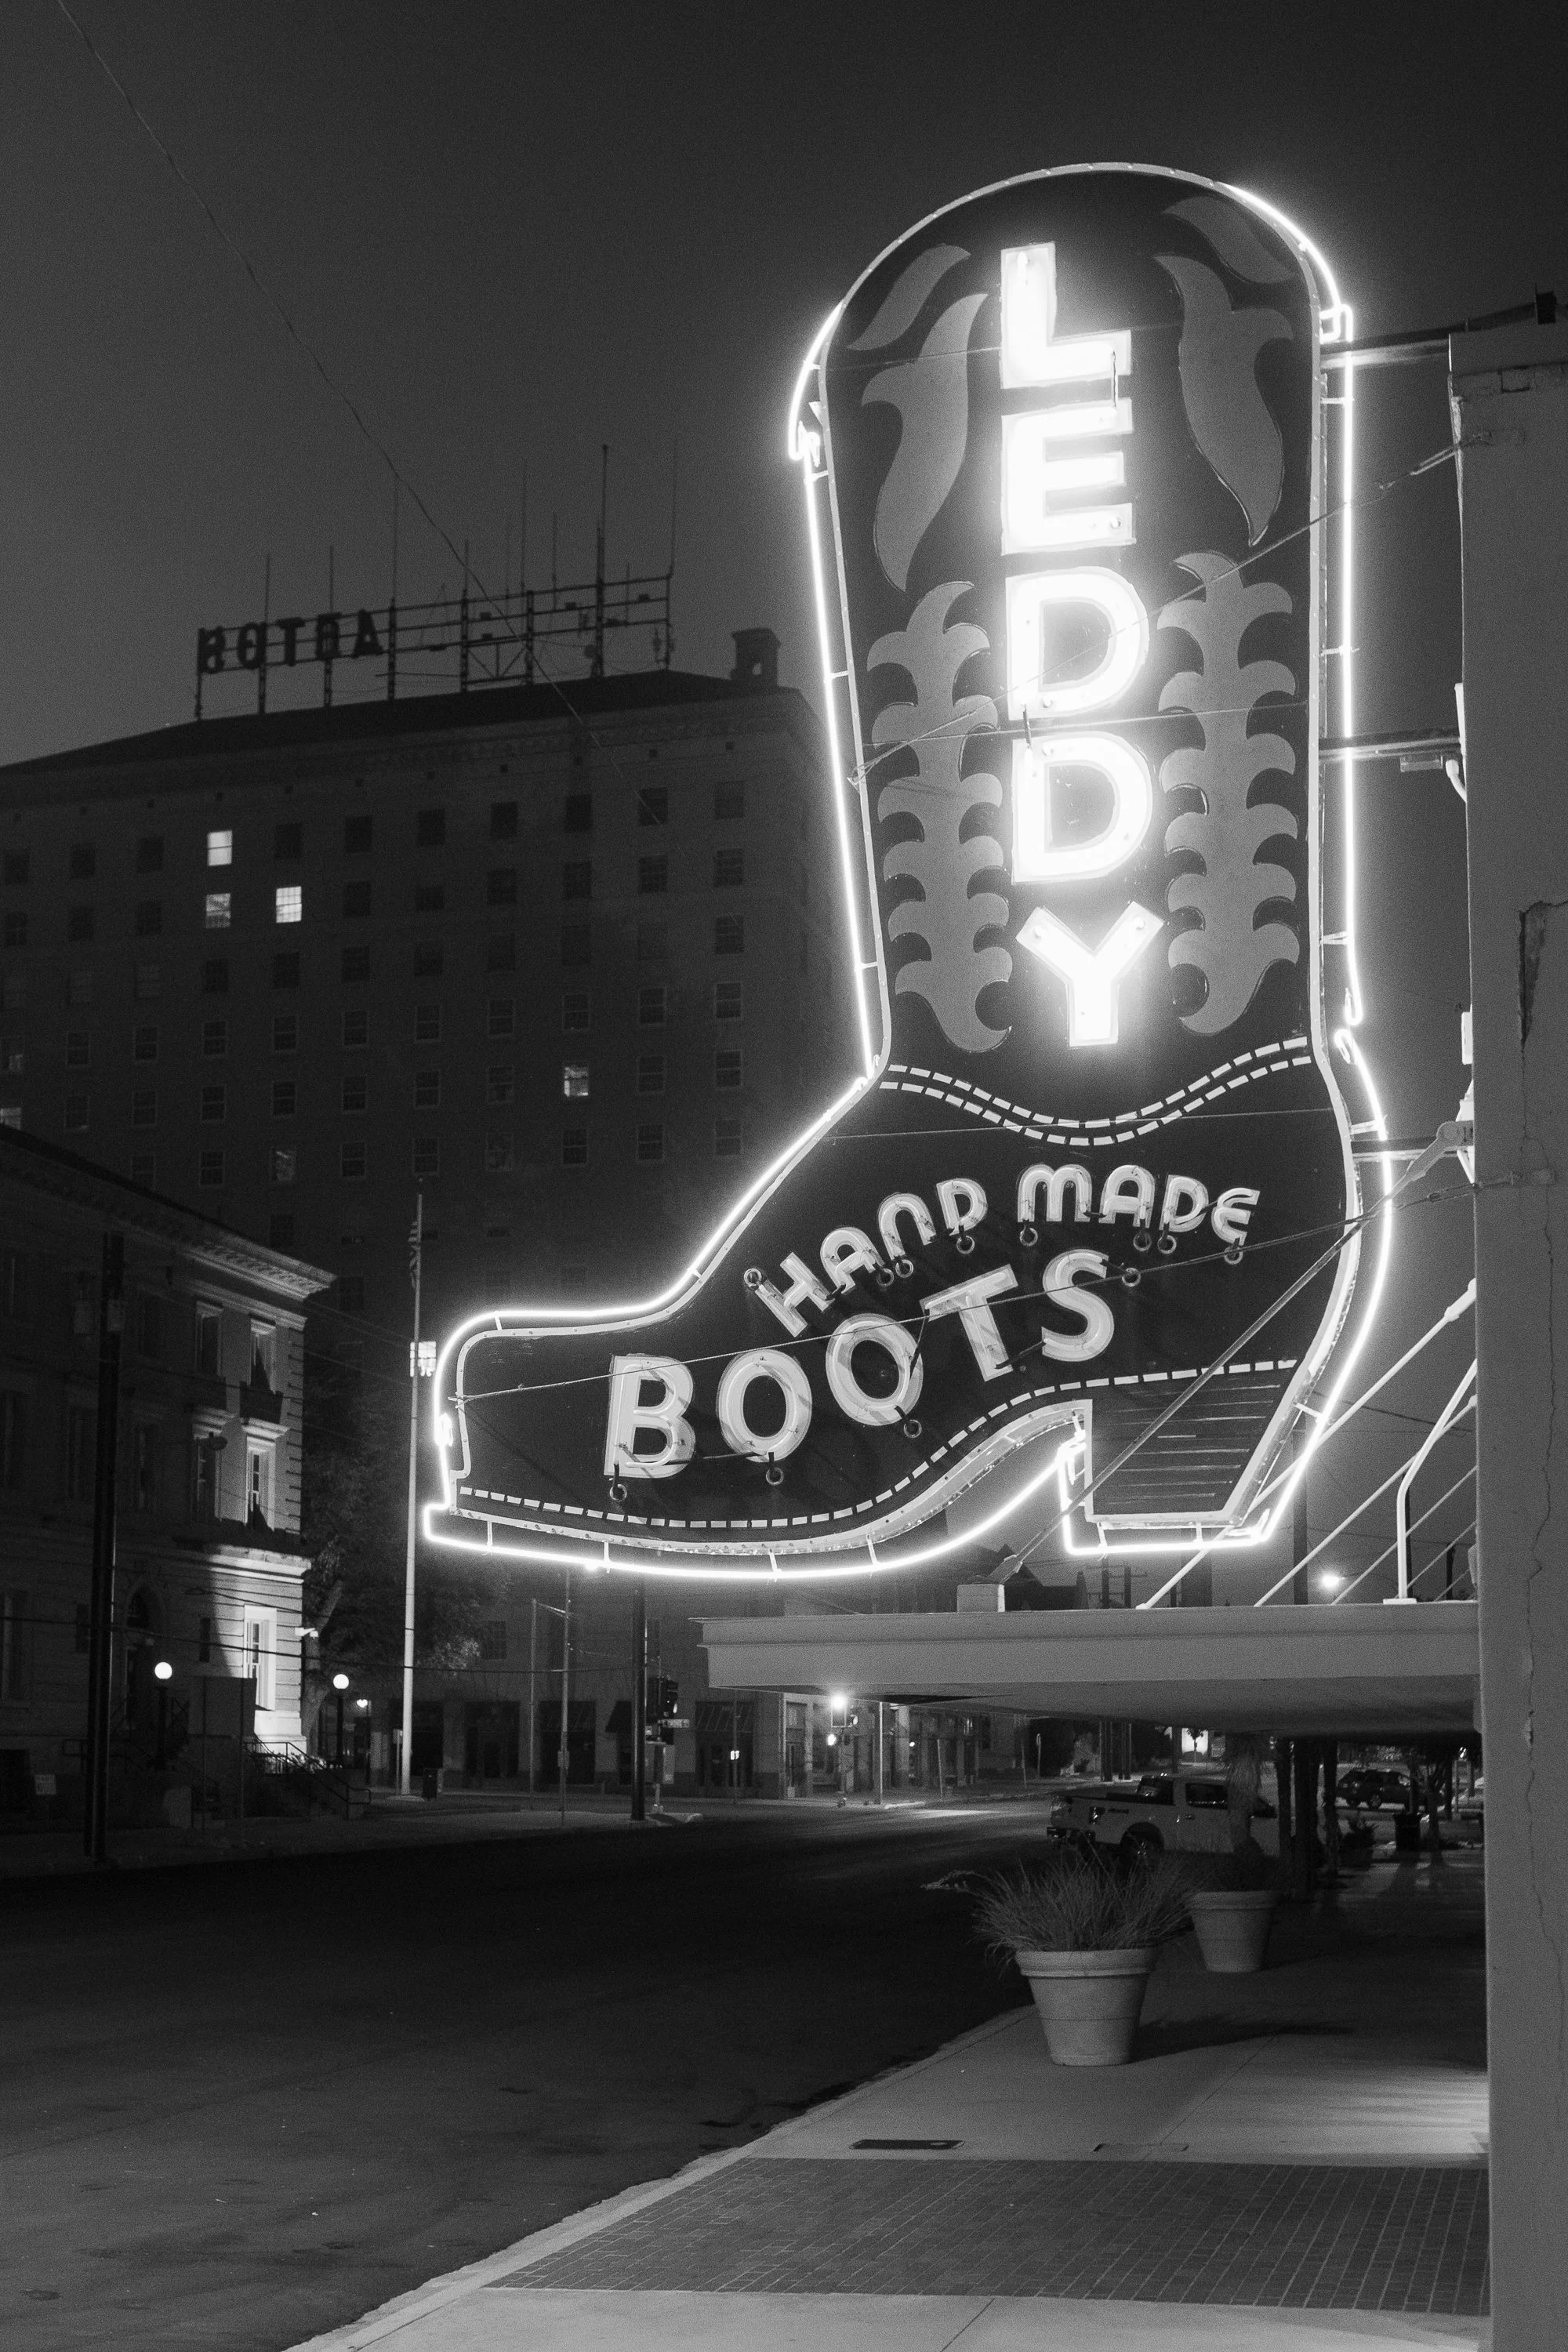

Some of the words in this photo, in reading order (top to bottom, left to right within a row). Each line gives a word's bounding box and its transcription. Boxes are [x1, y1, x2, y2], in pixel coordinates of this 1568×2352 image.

[1000, 242, 1164, 1047] LEDDY
[603, 1247, 1115, 1479] BOOTS
[751, 1177, 988, 1338] HAND
[1017, 1163, 1261, 1245] MADE
